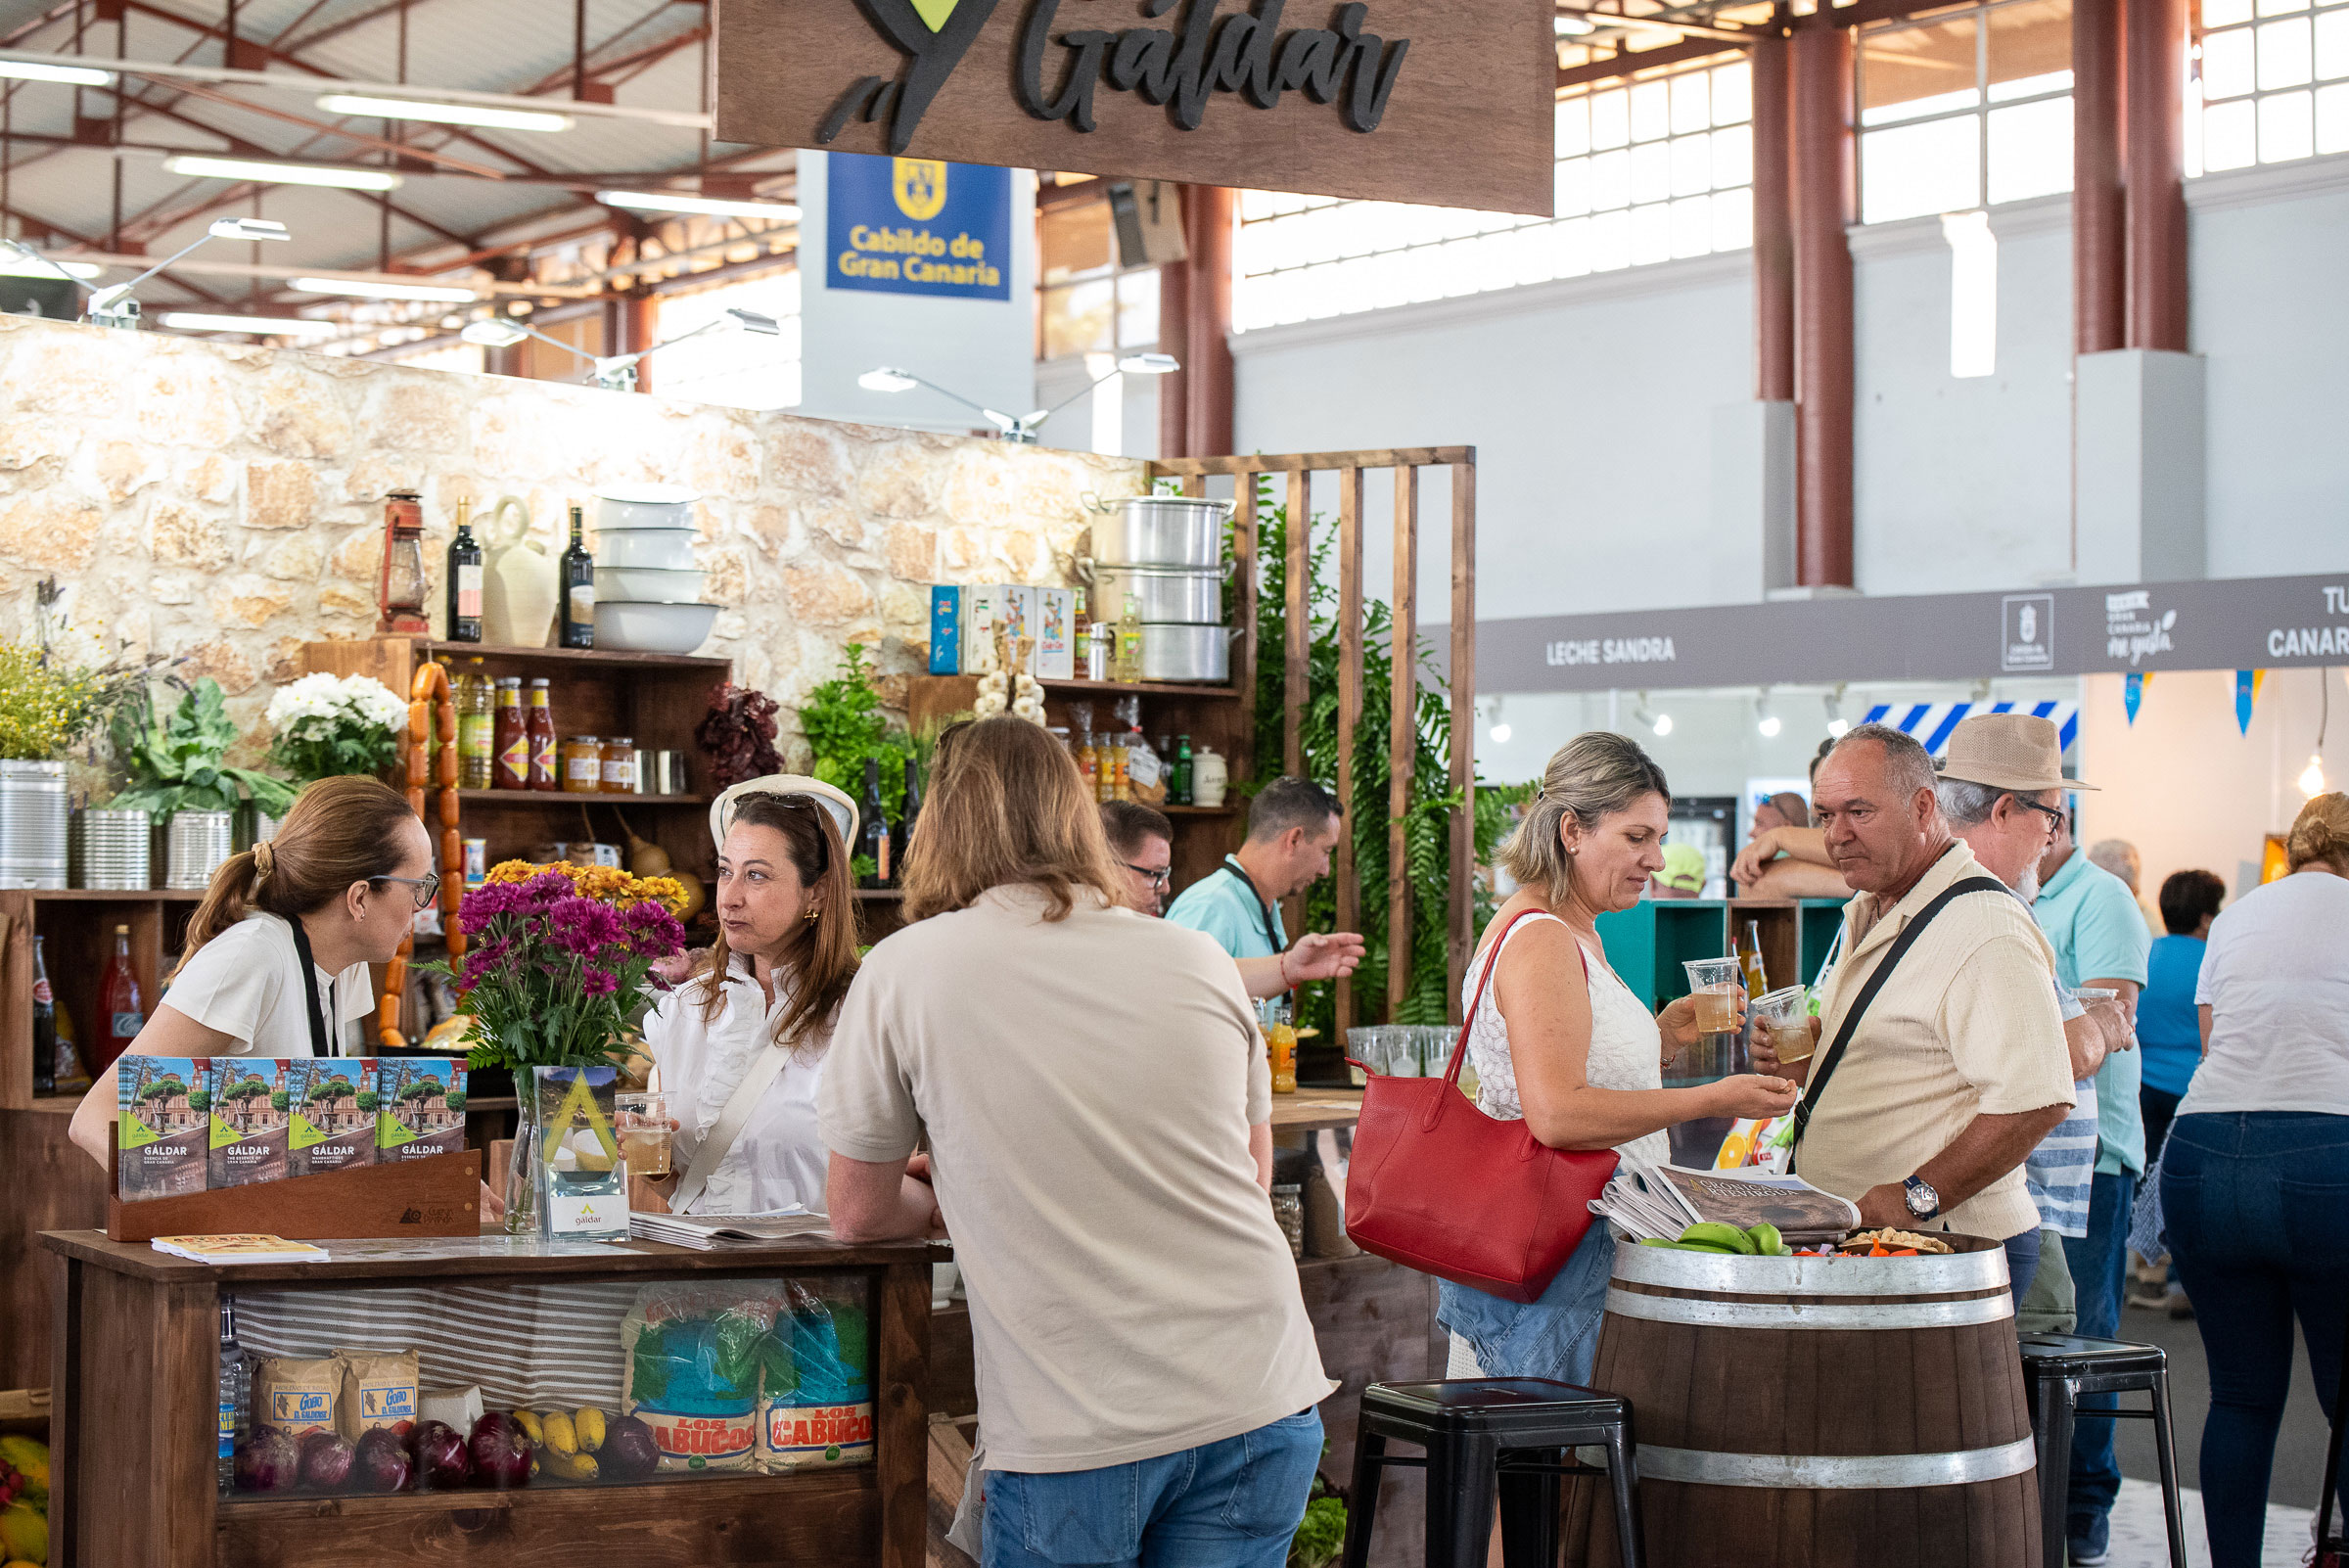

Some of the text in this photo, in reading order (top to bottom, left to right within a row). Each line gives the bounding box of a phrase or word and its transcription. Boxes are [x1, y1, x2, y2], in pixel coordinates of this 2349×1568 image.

[850, 225, 985, 259] Cabildo de
[839, 250, 1000, 287] Gran Canaria
[2267, 626, 2349, 658] CANAR
[1546, 635, 1676, 666] LECHE SANDRA
[144, 1145, 187, 1155] GÁLDAR
[227, 1145, 269, 1155] GÁLDAR
[312, 1145, 354, 1155] GÁLDAR
[402, 1144, 443, 1154] GÁLDAR
[576, 1216, 601, 1225] gáldar
[814, 1407, 856, 1419] LOS
[677, 1418, 726, 1430] LOS
[773, 1415, 872, 1446] CABUCO
[650, 1425, 755, 1454] ABUCOS
